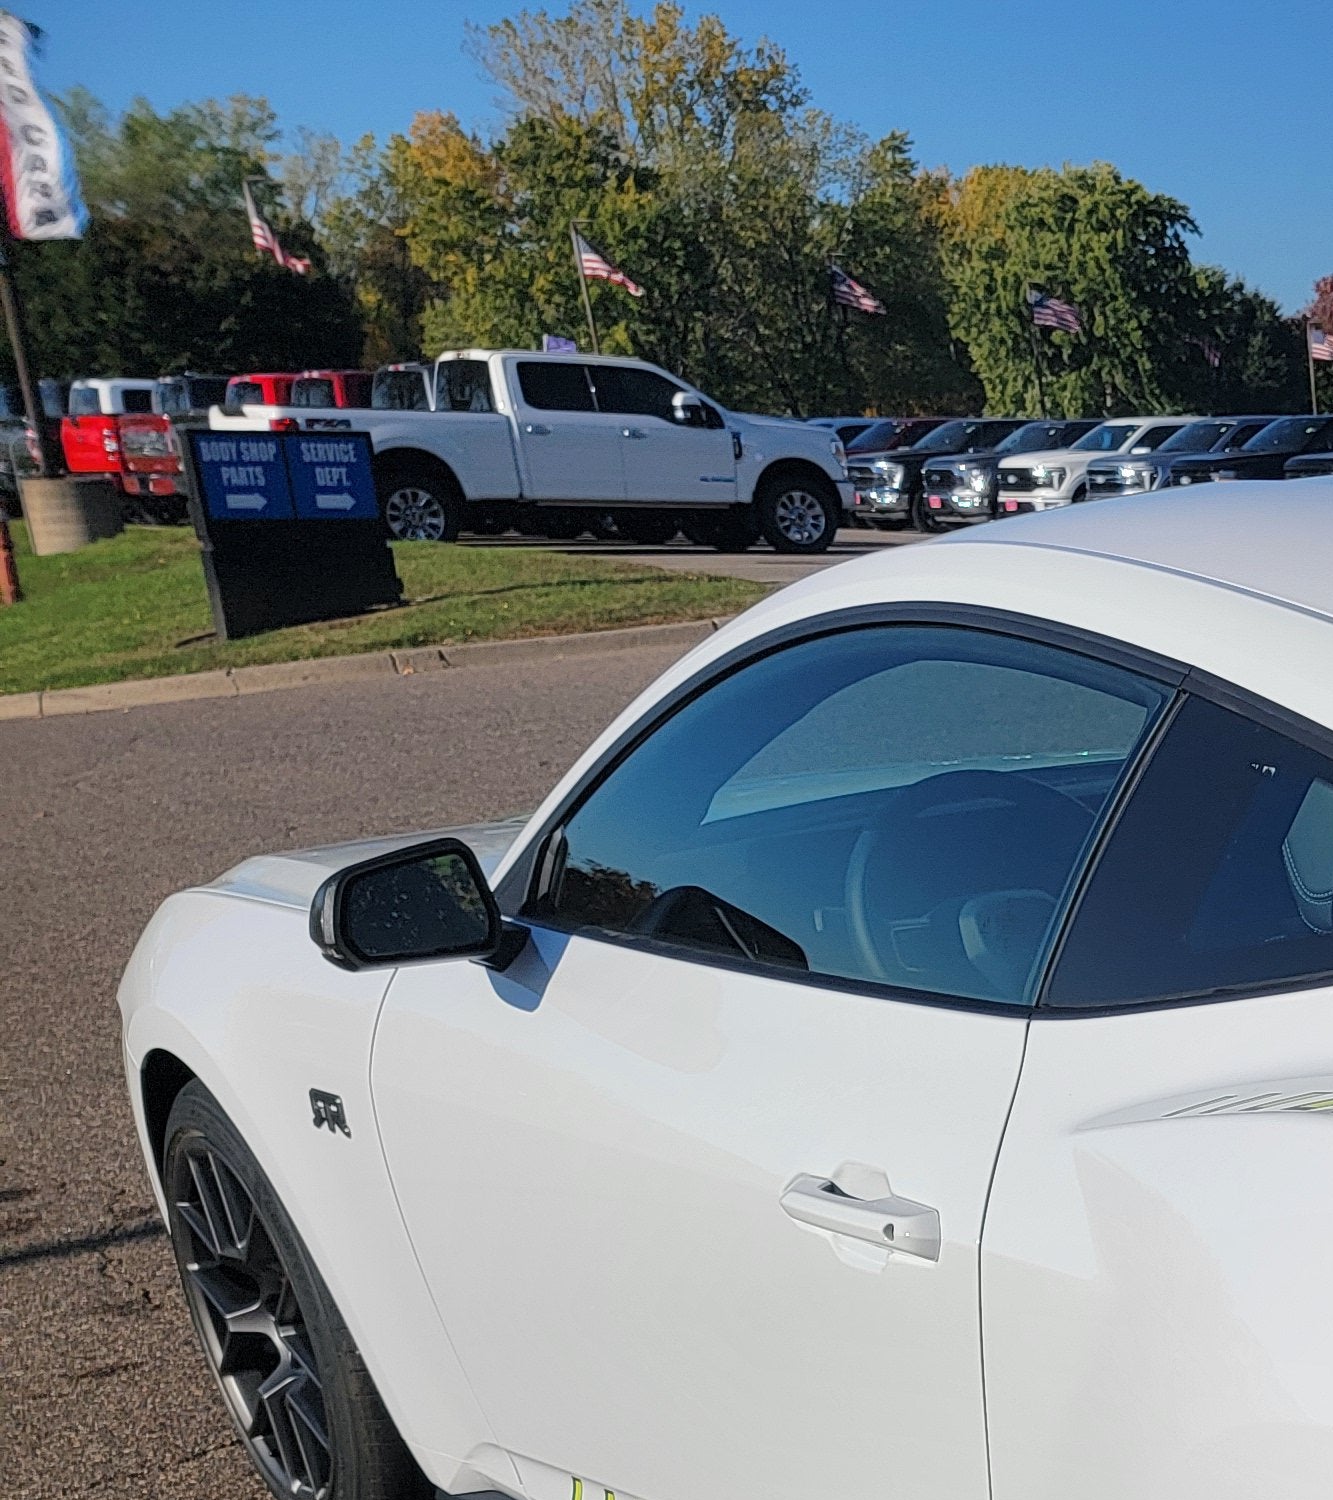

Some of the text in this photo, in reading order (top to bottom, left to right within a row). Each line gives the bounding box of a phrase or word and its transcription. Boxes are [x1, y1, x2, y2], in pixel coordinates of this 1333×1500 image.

[200, 441, 277, 463] BODY SHOP
[300, 442, 358, 464] SERVICE
[220, 465, 267, 487] PARTS
